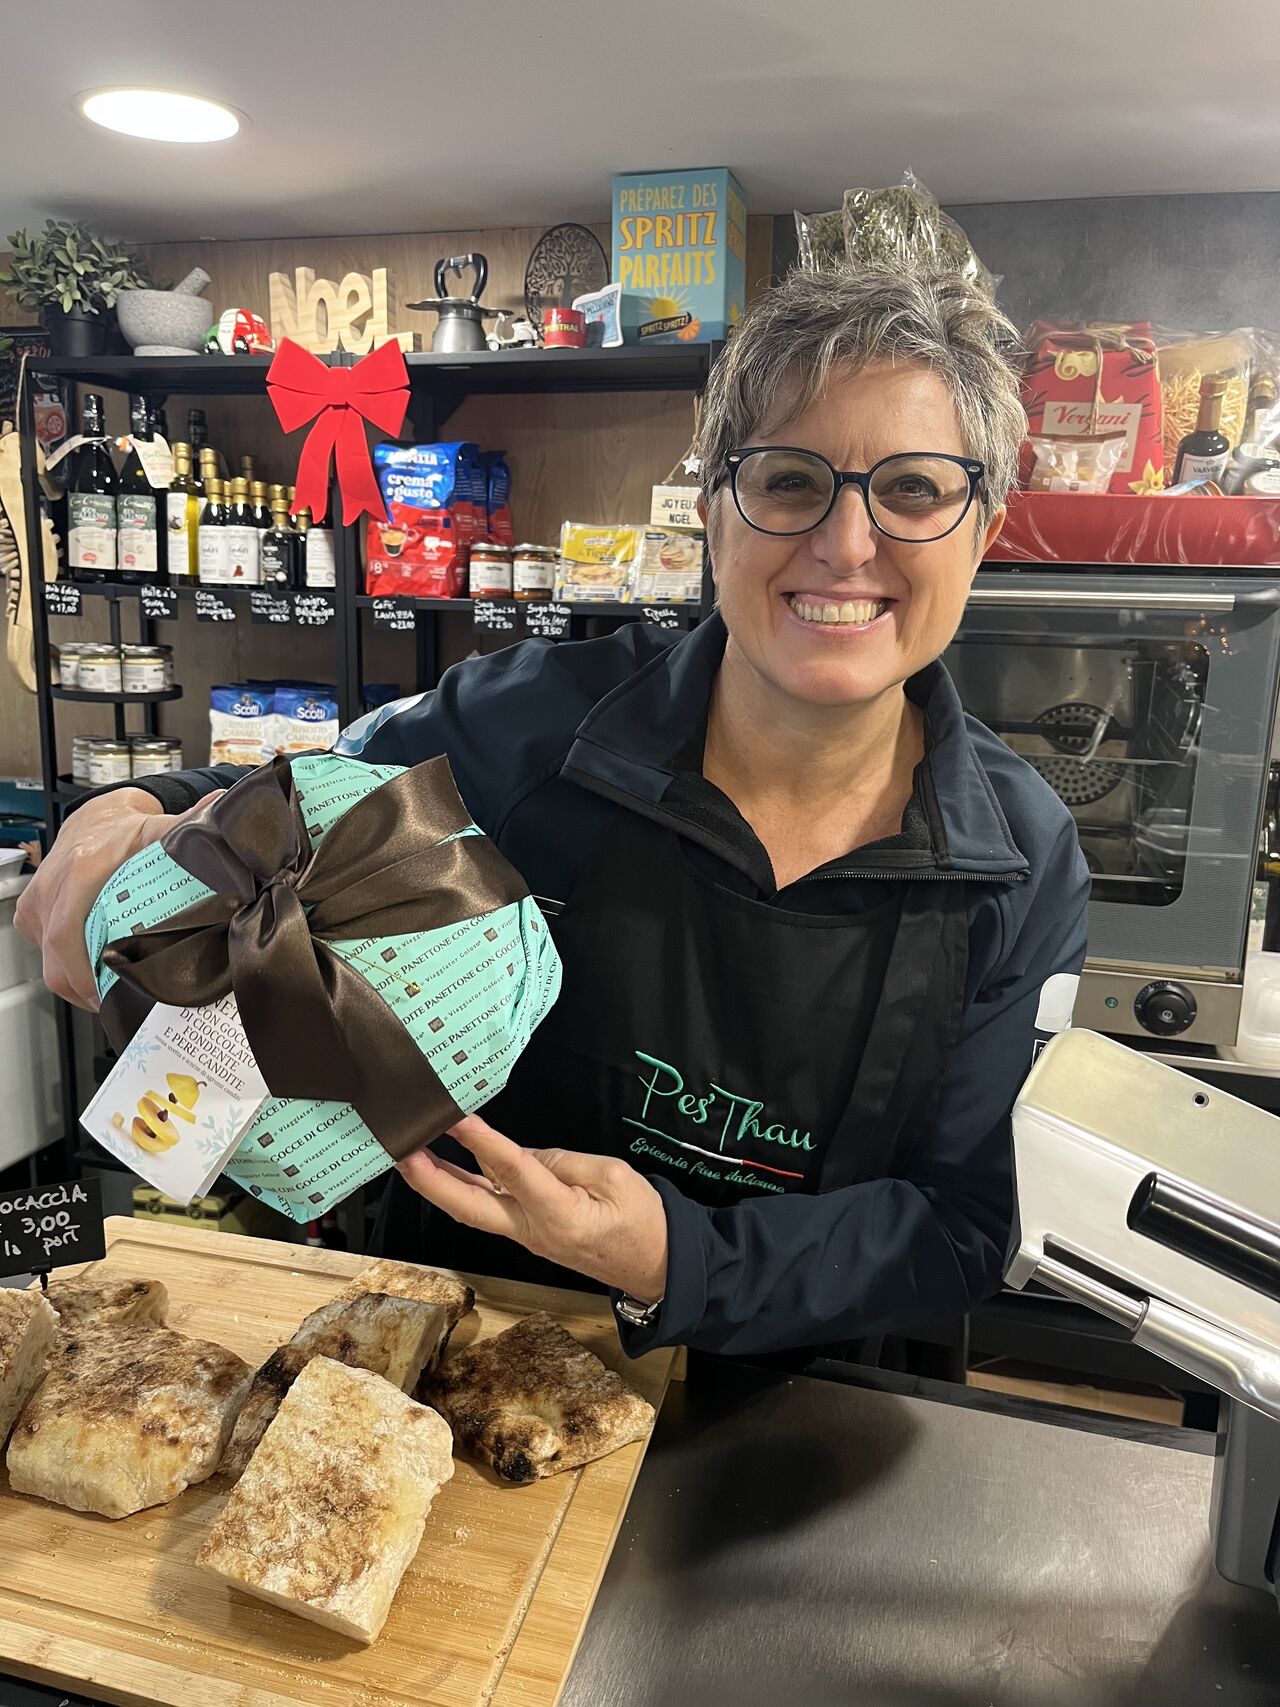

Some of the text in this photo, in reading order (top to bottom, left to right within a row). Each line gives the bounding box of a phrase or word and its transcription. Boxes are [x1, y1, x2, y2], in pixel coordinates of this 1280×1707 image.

[620, 182, 718, 212] PRÉPAREZ DES
[619, 211, 717, 250] SPRITZ
[619, 251, 716, 289] PARFAITS
[387, 474, 433, 487] crema
[393, 486, 434, 502] gusto
[233, 704, 259, 716] Scotti
[297, 707, 325, 720] Scotti
[306, 785, 380, 816] PANETTONE CO
[111, 858, 156, 890] GOCCE DI
[121, 895, 156, 920] GOCCE
[157, 889, 168, 901] DI
[401, 937, 452, 974] PANETTONE
[451, 924, 471, 941] CON
[402, 1006, 426, 1026] DITE
[424, 969, 477, 1010] PANETTONE
[475, 955, 496, 973] CON
[196, 1005, 221, 1027] CON
[449, 1004, 501, 1044] PANETTONE
[180, 1008, 257, 1069] DI CIOCCOLATO
[183, 1026, 240, 1072] FONDENTE
[471, 1035, 517, 1075] PANETTONE
[164, 1026, 245, 1092] E PERE CANDITE
[270, 1105, 355, 1164] GOCCE DI CIOCCO
[295, 1165, 330, 1191] GOCCE
[328, 1160, 341, 1171] DI
[341, 1137, 378, 1163] CIOCCO
[689, 1161, 721, 1180] fine
[21, 1211, 70, 1237] 3,00
